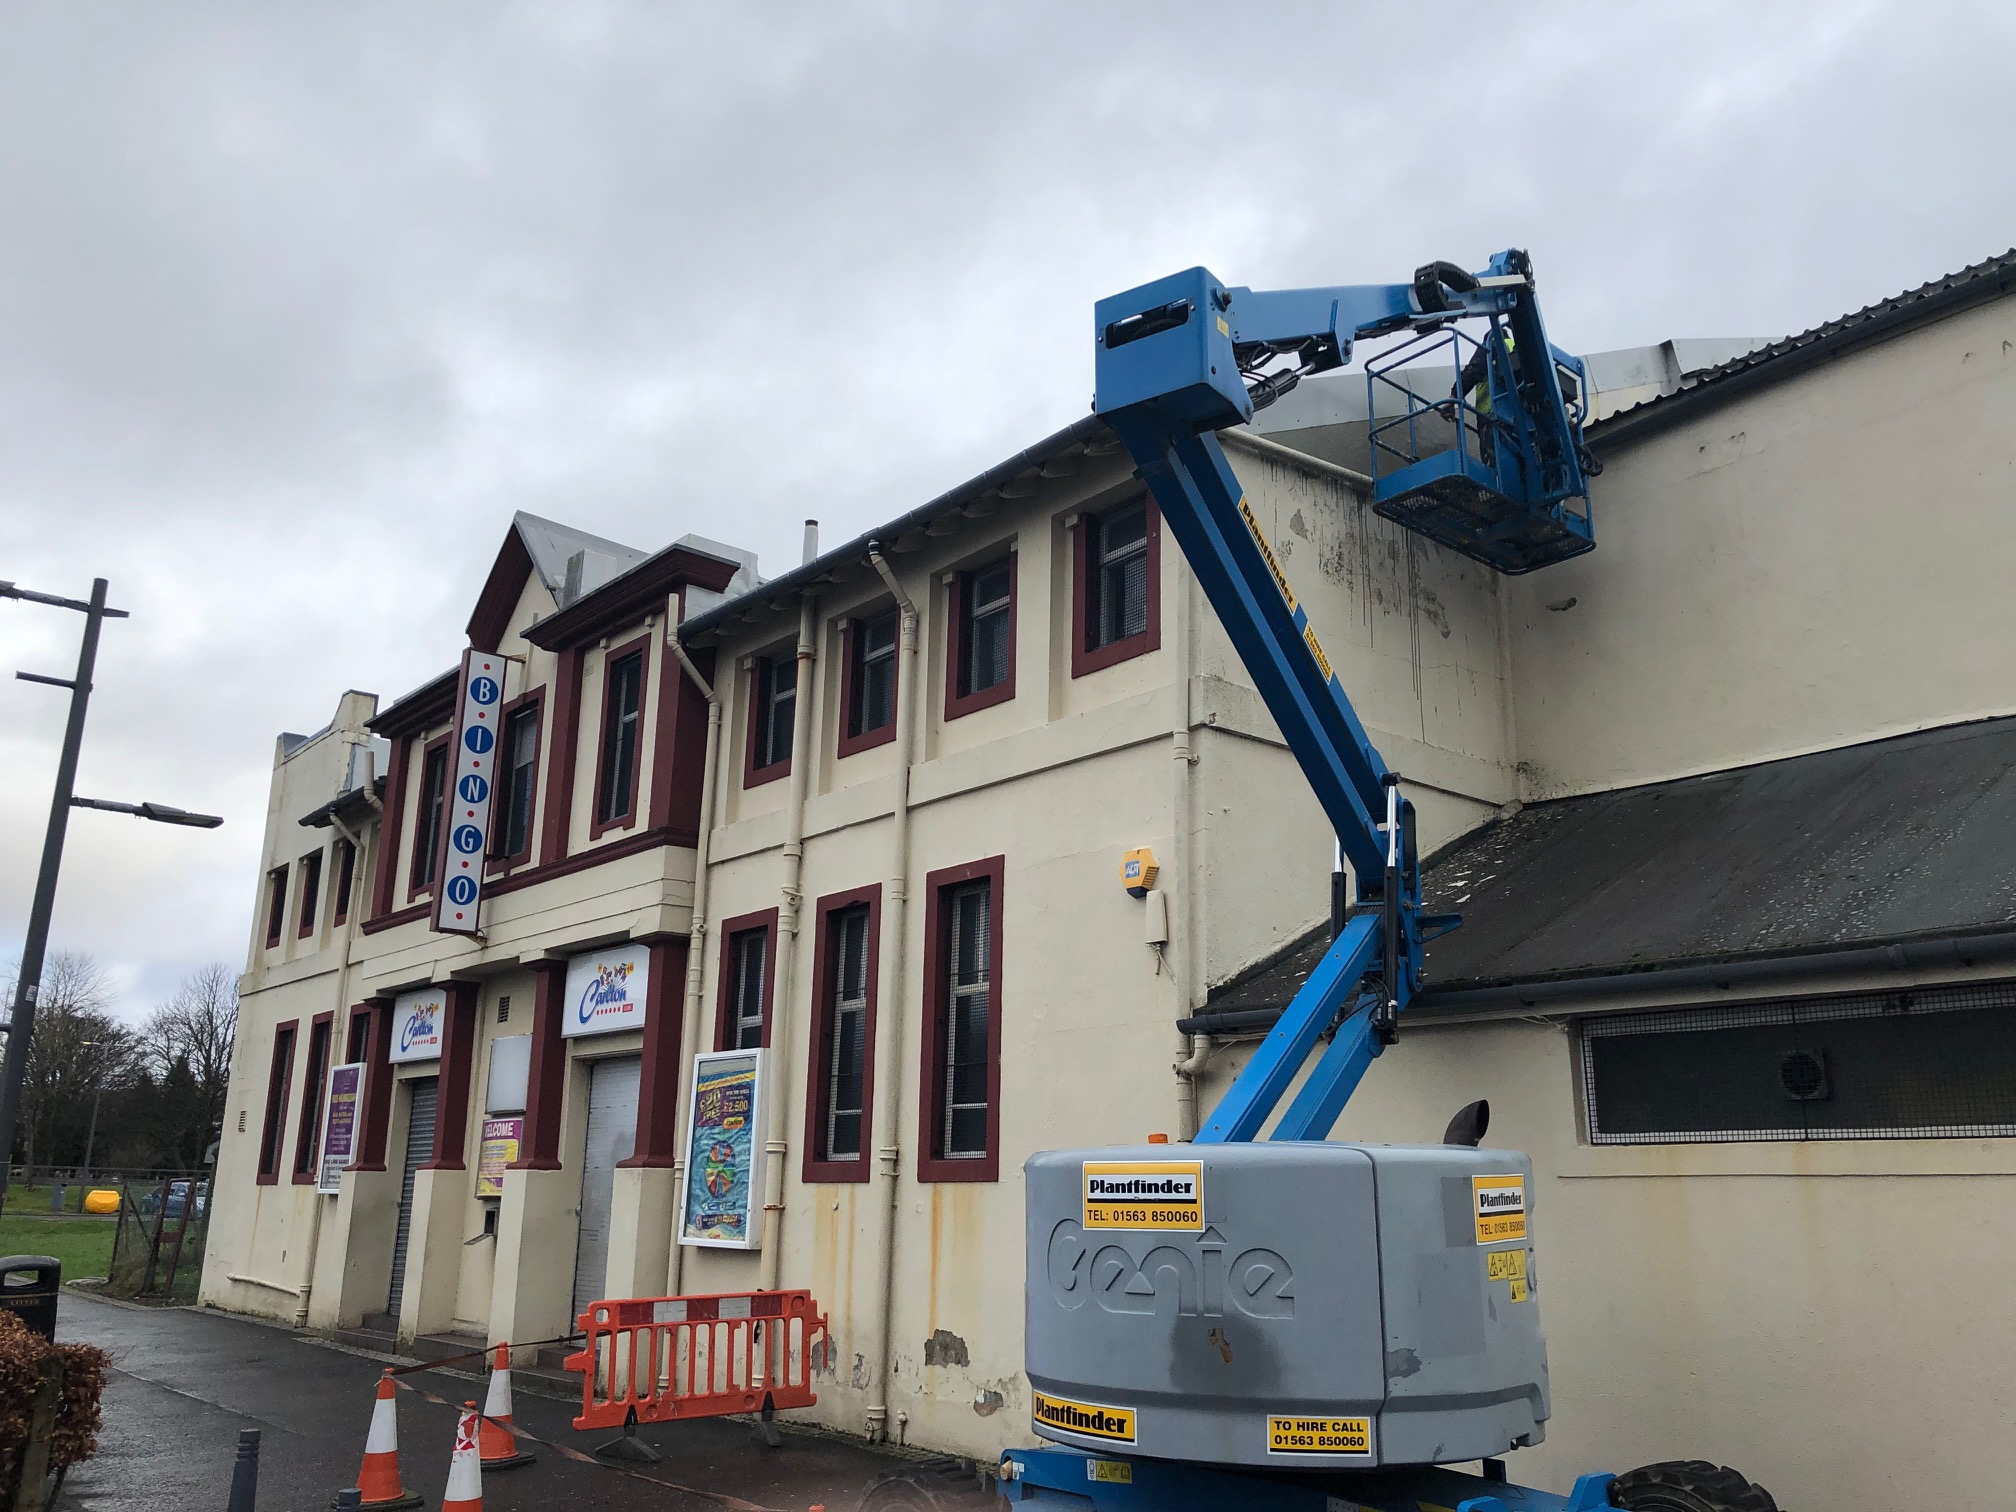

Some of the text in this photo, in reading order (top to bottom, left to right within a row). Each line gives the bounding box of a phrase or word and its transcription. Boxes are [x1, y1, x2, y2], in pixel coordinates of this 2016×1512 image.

[455, 678, 491, 903] BINGO
[578, 978, 627, 1025] Carlton
[484, 1122, 515, 1138] WELCOME
[1089, 1179, 1193, 1194] Plantfinder
[1479, 1191, 1522, 1208] Plantfinder
[1087, 1209, 1198, 1223] TEL: 01563 850060
[1035, 1396, 1127, 1434] Plantfinder
[1273, 1420, 1364, 1432] TO HIRE CALL
[1274, 1434, 1364, 1447] 01563 850060
